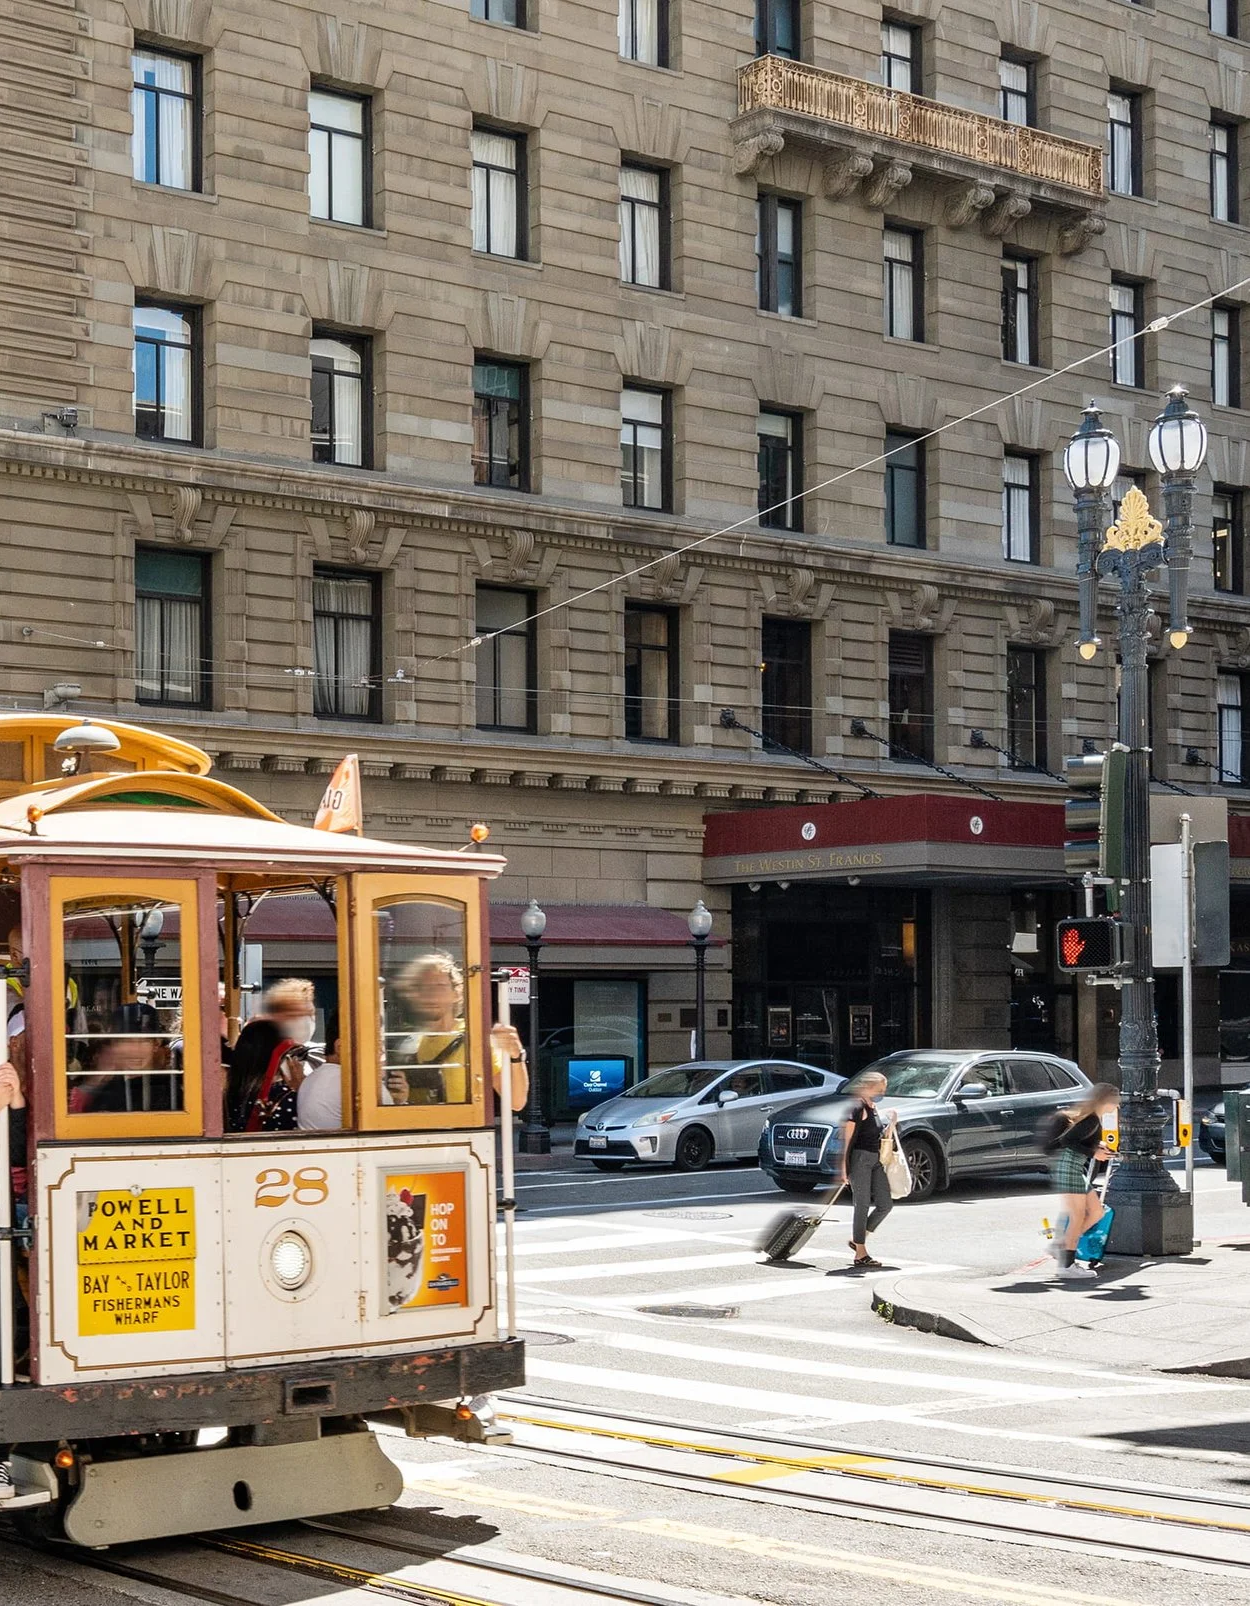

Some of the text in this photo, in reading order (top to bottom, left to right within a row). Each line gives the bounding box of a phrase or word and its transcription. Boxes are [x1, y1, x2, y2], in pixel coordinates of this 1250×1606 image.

[734, 852, 883, 873] THE WESTIN ST. FRANCIS
[254, 1166, 330, 1209] 28
[87, 1198, 188, 1218] POWELL
[430, 1203, 455, 1216] HOP
[112, 1217, 163, 1232] AND
[430, 1218, 448, 1231] ON
[82, 1231, 191, 1252] MARKET
[430, 1234, 447, 1246] TO
[83, 1275, 110, 1294] BAY
[136, 1270, 190, 1292] TAYLOR
[93, 1295, 181, 1312] FISHERMANS
[114, 1311, 159, 1325] WHARF
